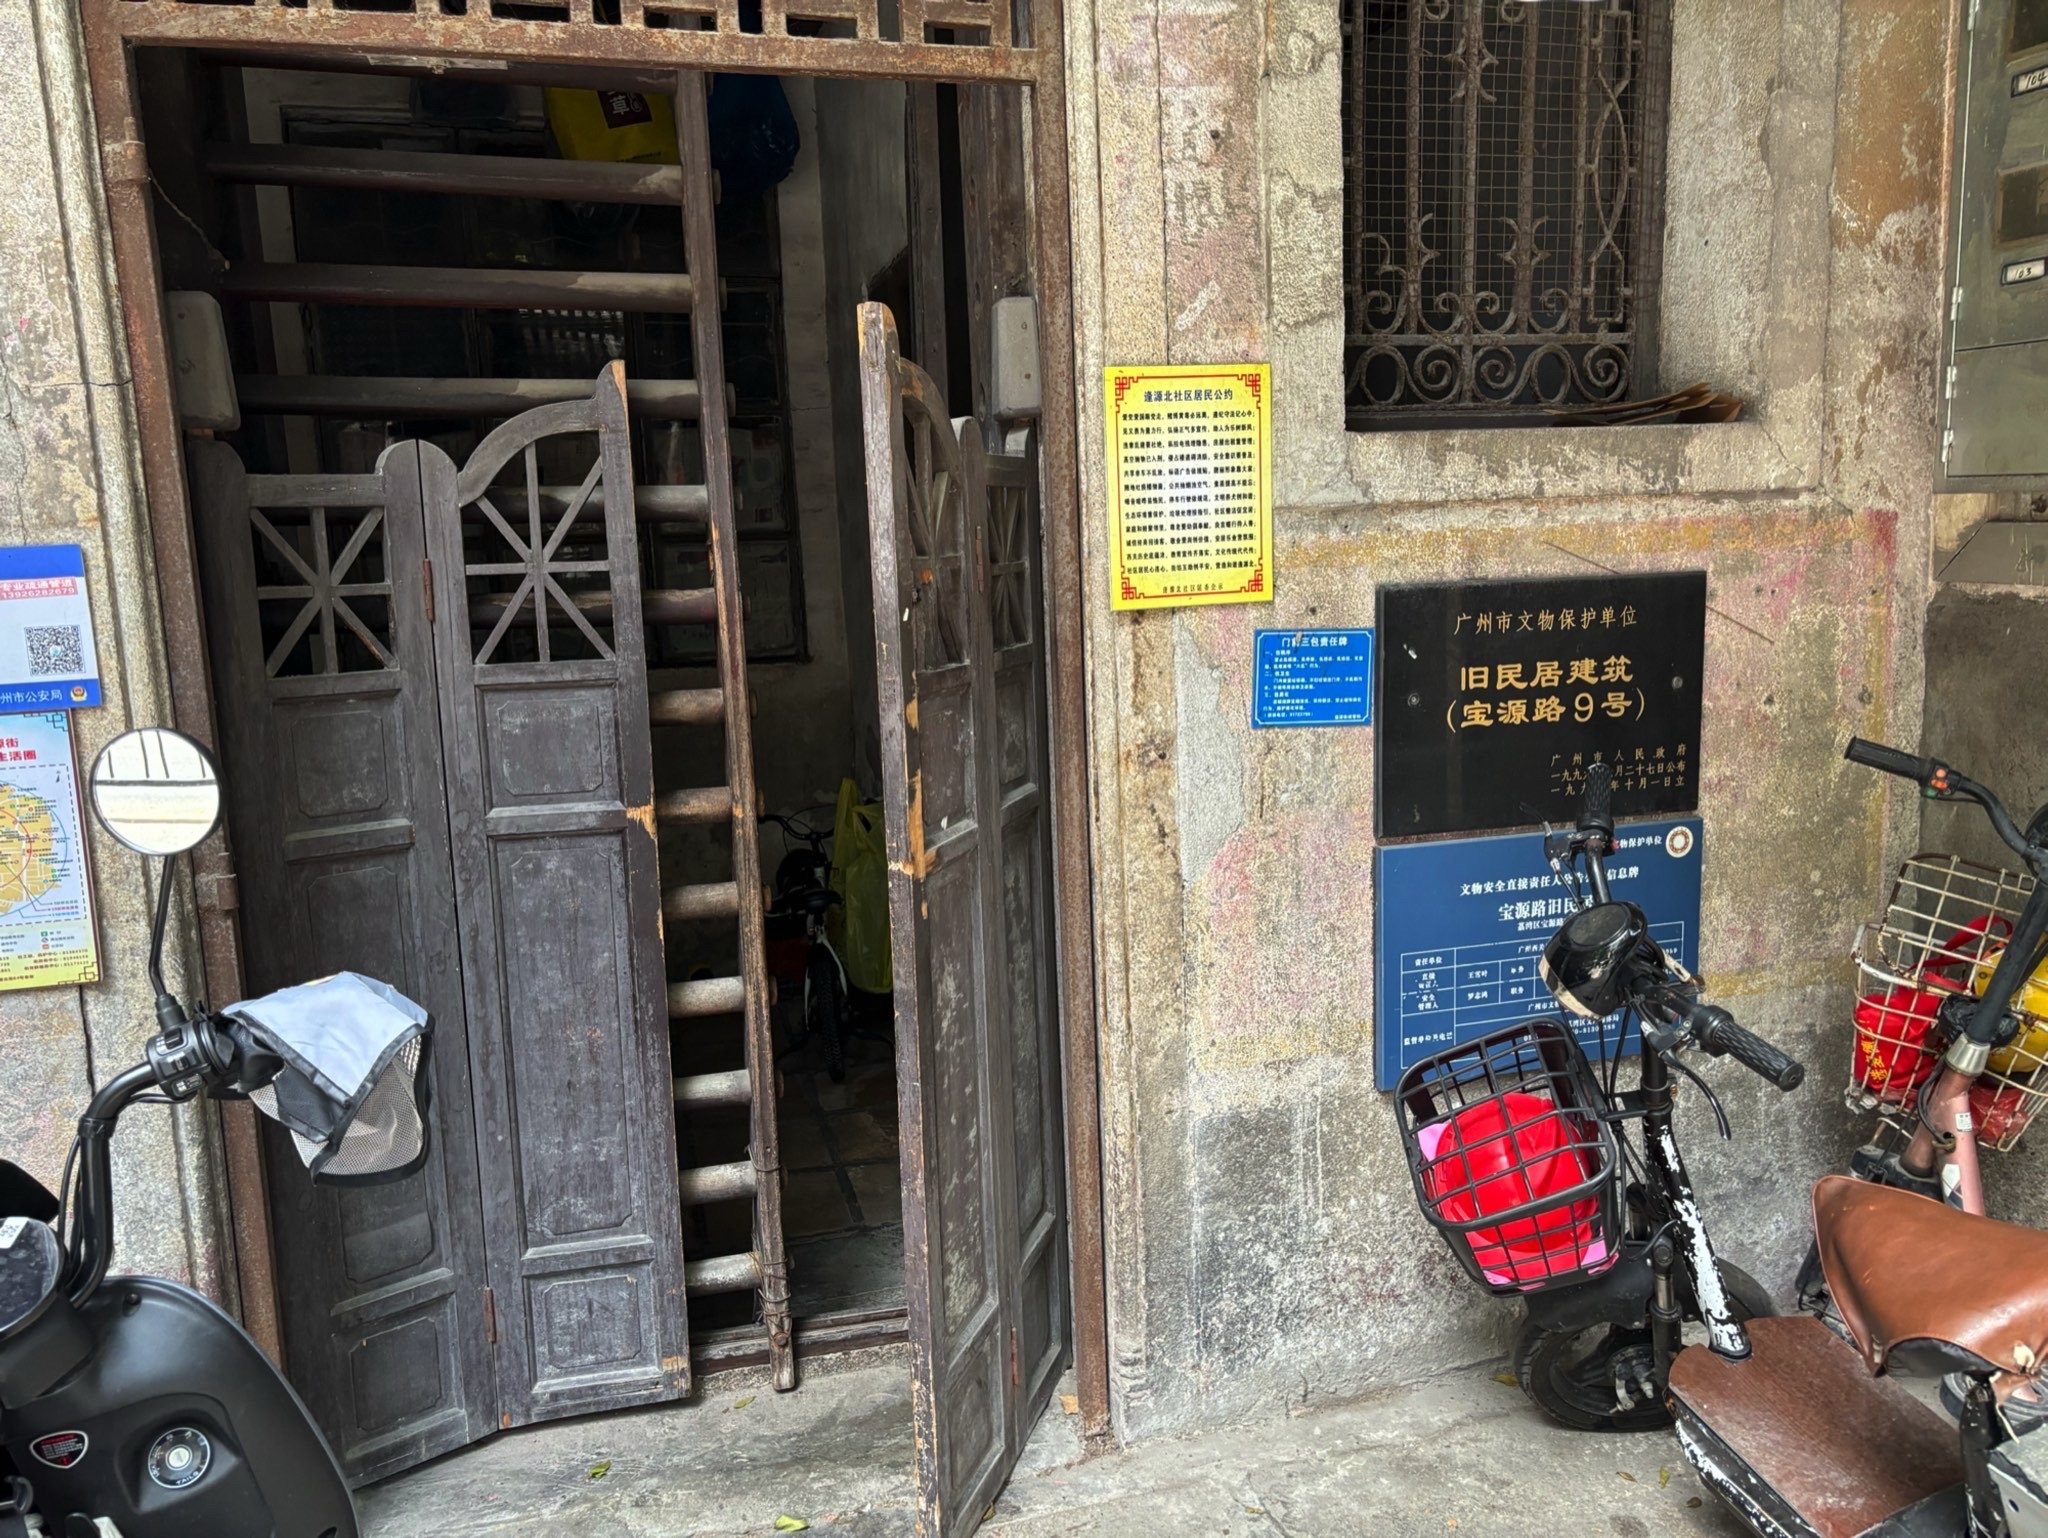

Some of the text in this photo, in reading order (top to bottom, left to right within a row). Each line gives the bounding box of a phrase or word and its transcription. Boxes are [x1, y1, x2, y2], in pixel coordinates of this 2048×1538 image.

[1144, 389, 1234, 402] 逢源北社区居民公约
[1454, 604, 1638, 636] 广州市文物保护单位
[1460, 654, 1634, 692] 旧民居建筑
[1550, 743, 1686, 767] 广州市人民政府
[1551, 760, 1686, 782] 一九九月二十七日公布
[1551, 775, 1685, 796] 一九年十月一日立
[1517, 917, 1565, 932] 荔湾区宝源路
